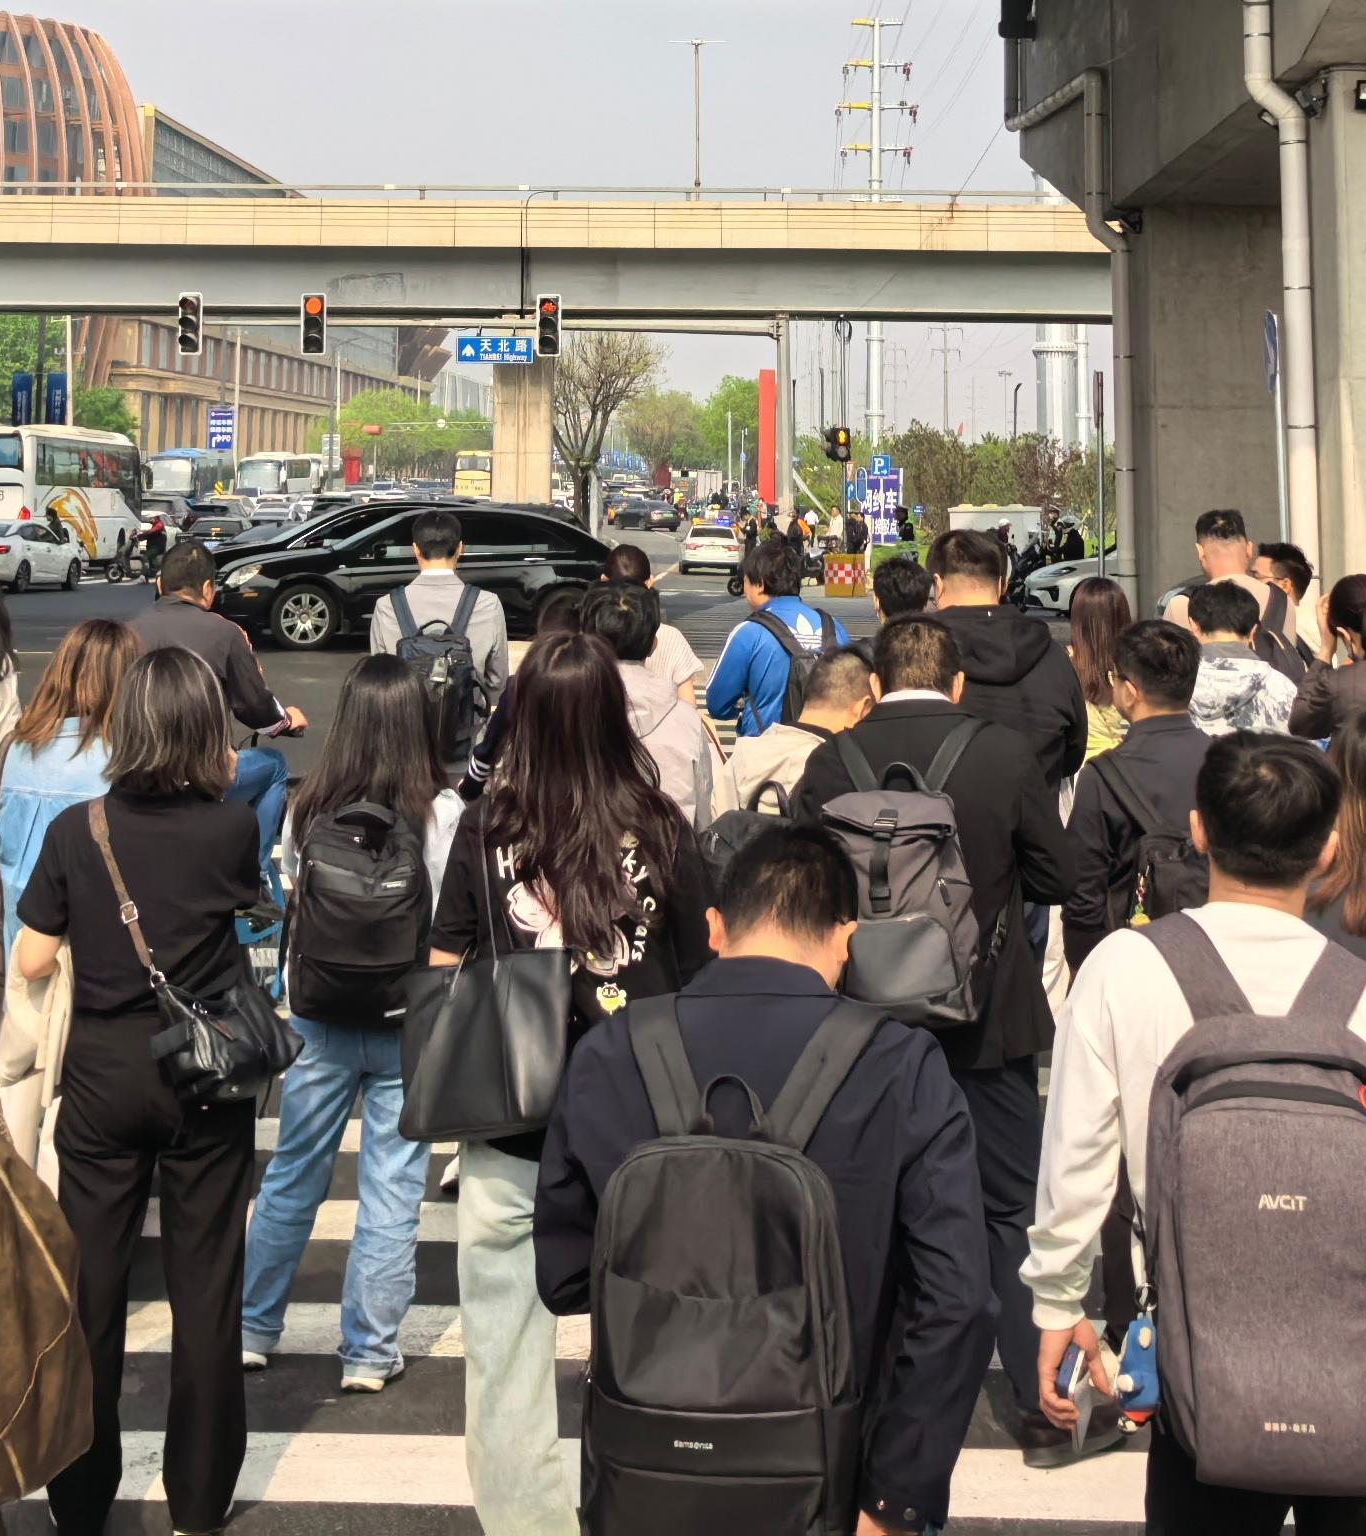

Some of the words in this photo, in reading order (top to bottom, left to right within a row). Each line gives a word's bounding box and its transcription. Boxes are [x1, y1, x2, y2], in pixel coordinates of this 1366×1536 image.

[479, 338, 527, 353] 天北路
[873, 457, 885, 475] P
